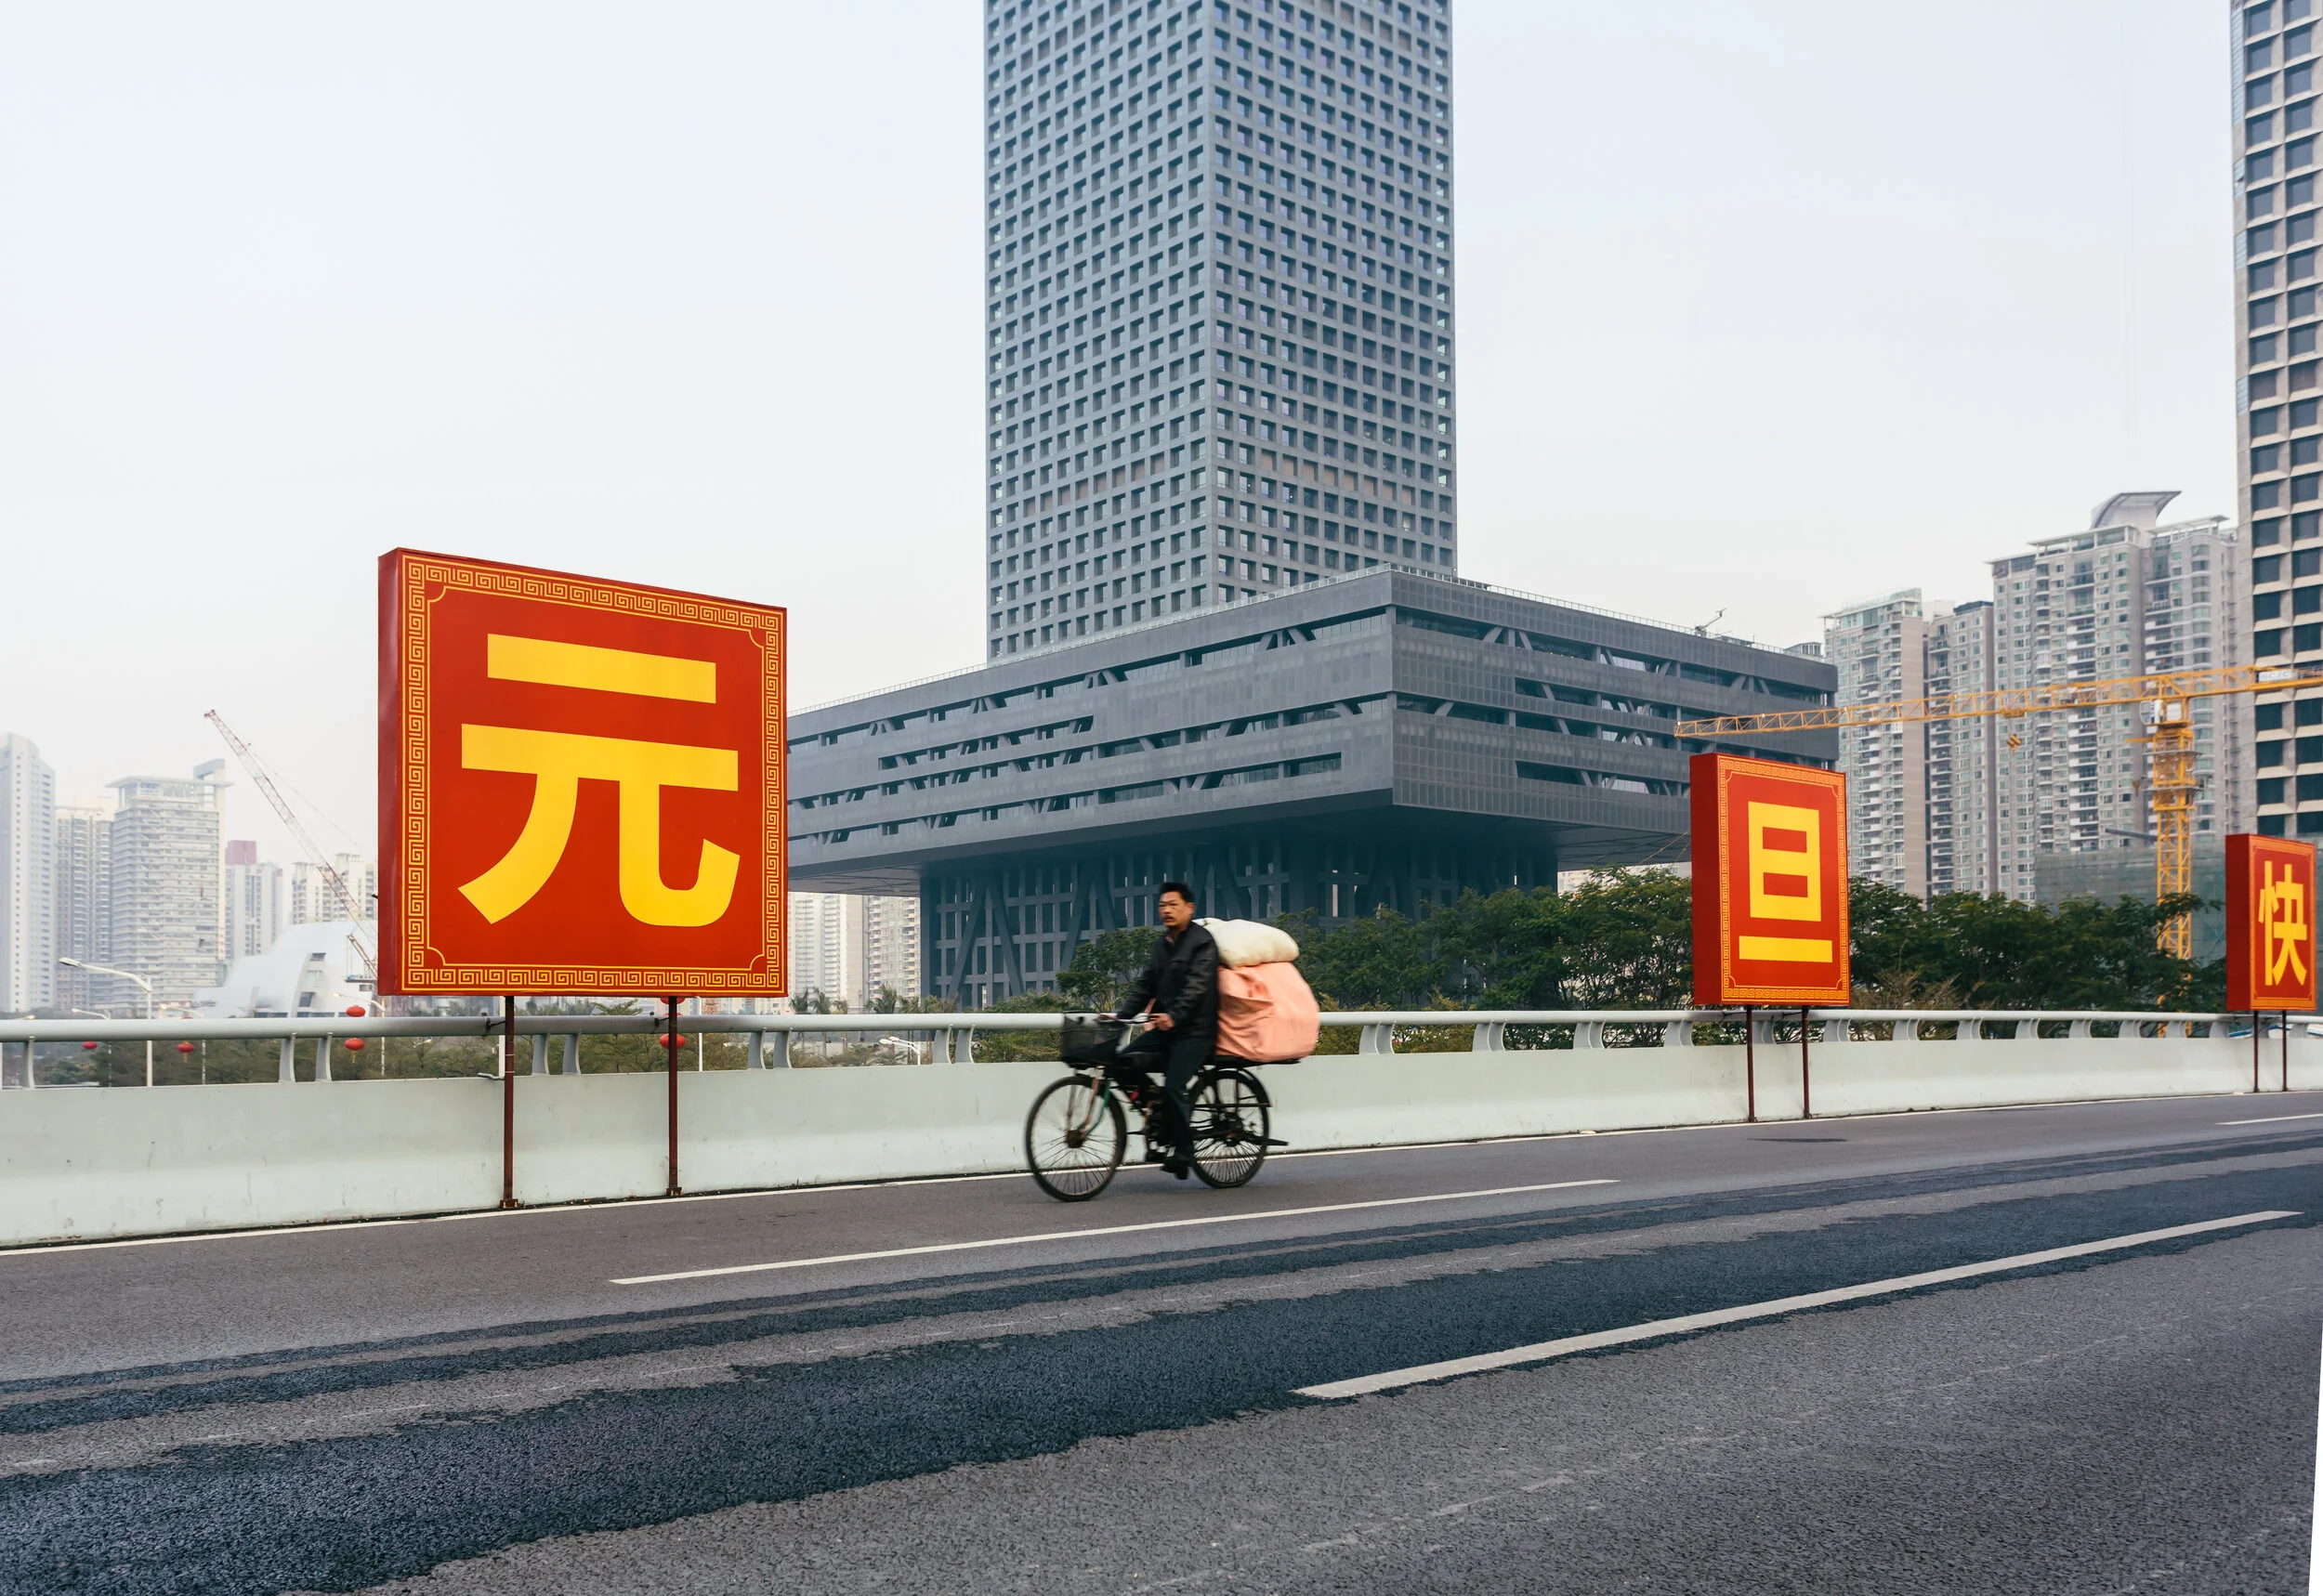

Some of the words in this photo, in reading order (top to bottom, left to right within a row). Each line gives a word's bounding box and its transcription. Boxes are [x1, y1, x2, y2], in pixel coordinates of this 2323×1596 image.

[457, 634, 740, 927] 元
[1739, 801, 1832, 962] 旦
[2258, 860, 2307, 987] 快
